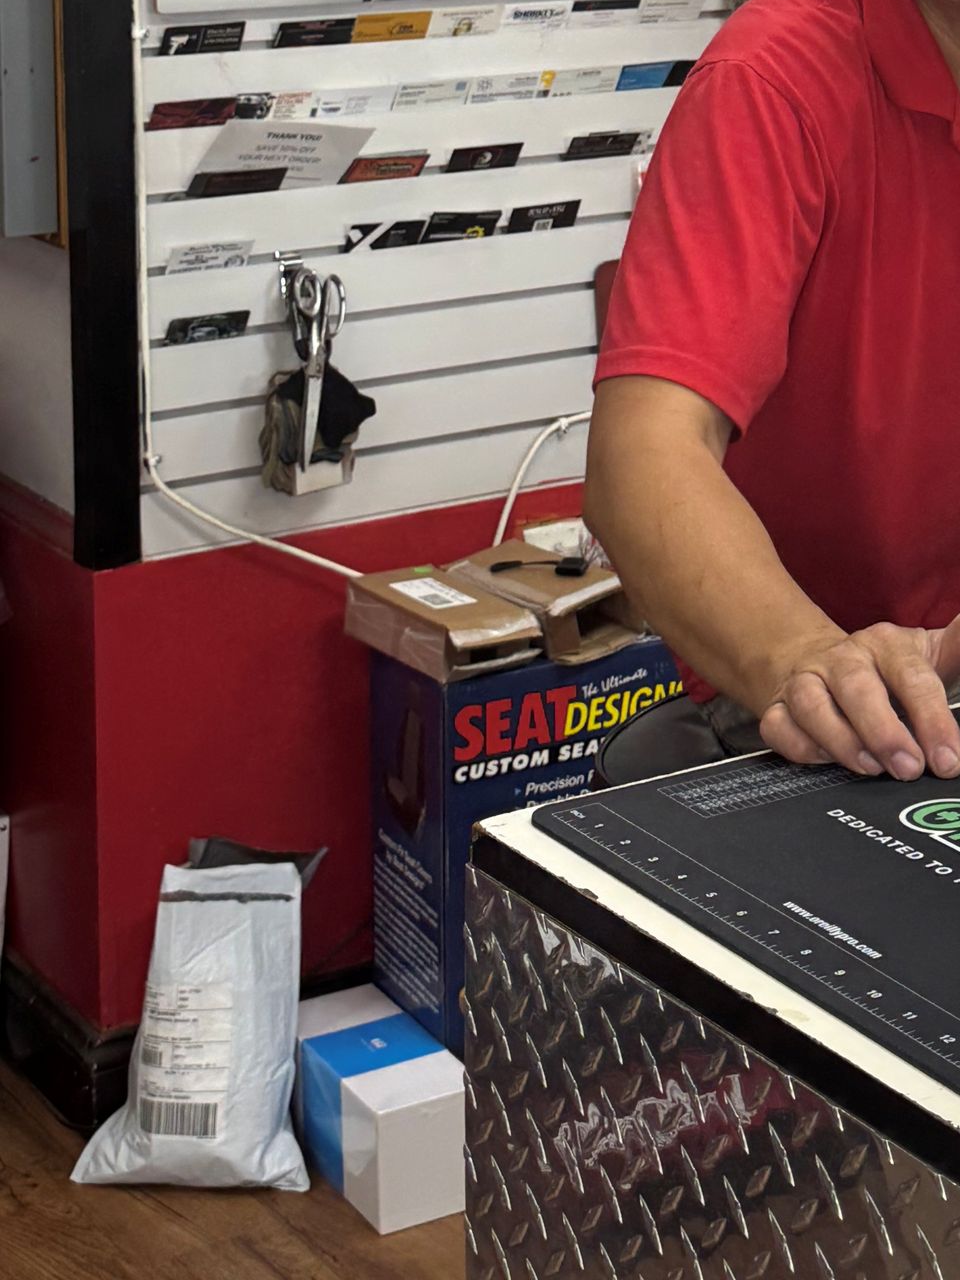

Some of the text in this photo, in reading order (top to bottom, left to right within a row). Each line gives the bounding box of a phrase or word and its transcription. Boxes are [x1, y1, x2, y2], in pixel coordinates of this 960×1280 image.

[582, 667, 648, 700] The Ultimate
[454, 685, 577, 762] SEAT
[454, 736, 605, 784] CUSTOM SEA
[525, 773, 585, 797] Precision
[827, 808, 924, 860] DEDICATED
[925, 860, 953, 875] TO
[782, 900, 883, 960] www.oreillypro.com
[834, 968, 846, 977] 9
[866, 989, 882, 999] 10
[902, 1010, 918, 1020] 11
[939, 1034, 956, 1045] 12
